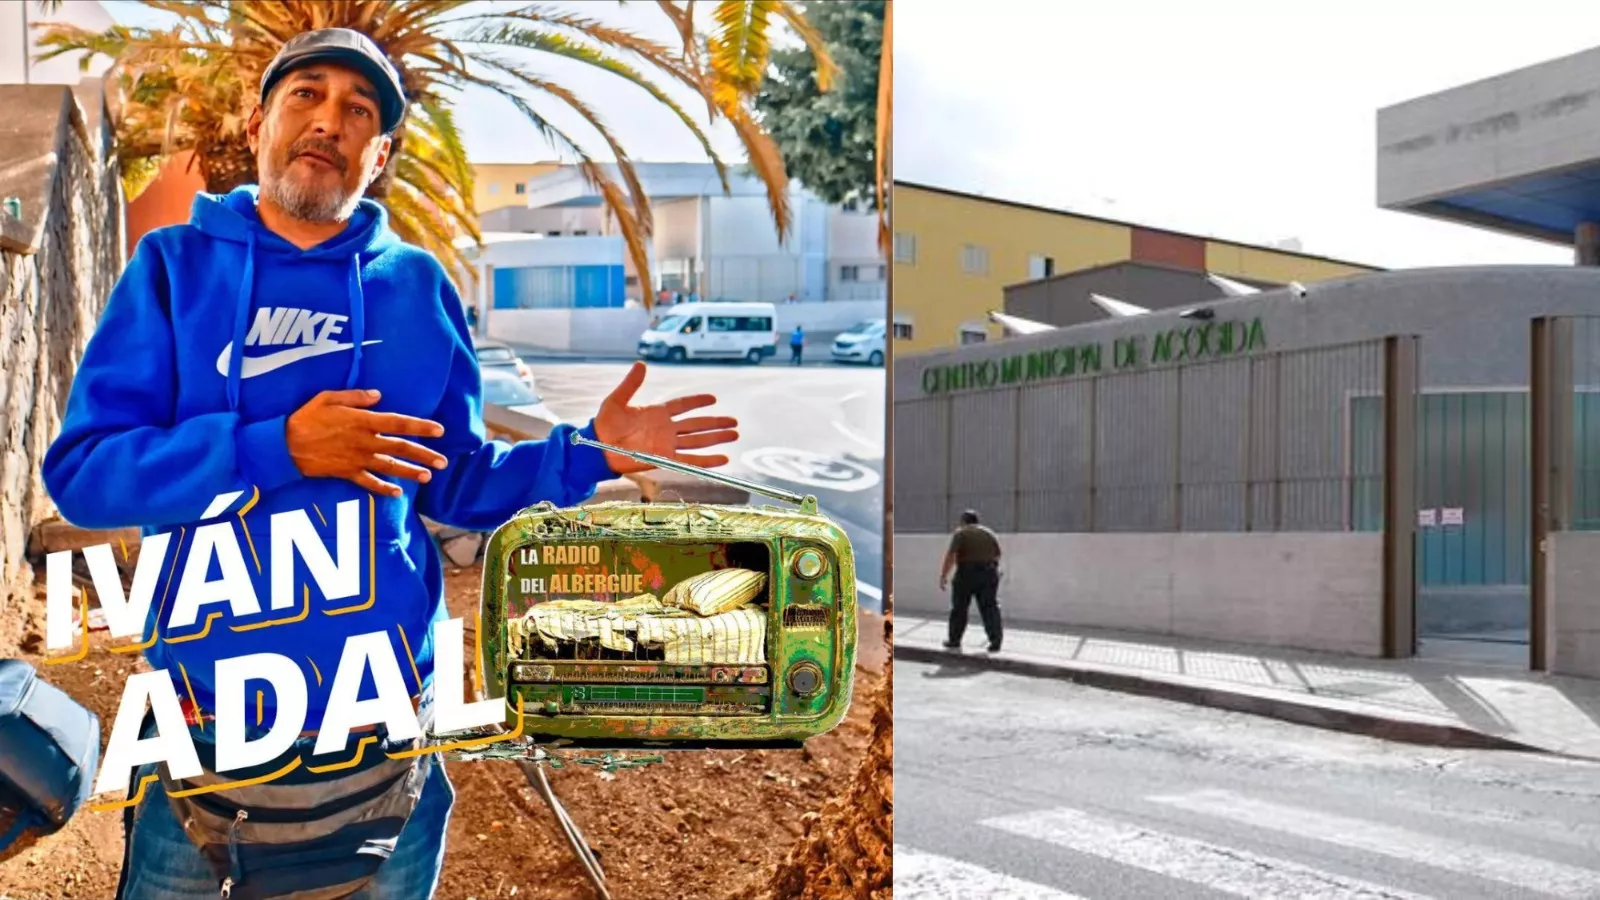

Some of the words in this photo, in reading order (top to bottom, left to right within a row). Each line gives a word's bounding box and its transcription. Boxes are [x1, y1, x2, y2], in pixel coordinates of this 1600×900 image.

[244, 306, 349, 346] NIKE
[922, 358, 999, 394] CENTRO
[1000, 341, 1102, 385] MUNICIPAL
[1114, 333, 1145, 368] DE
[1152, 317, 1267, 364] ACOGIDA
